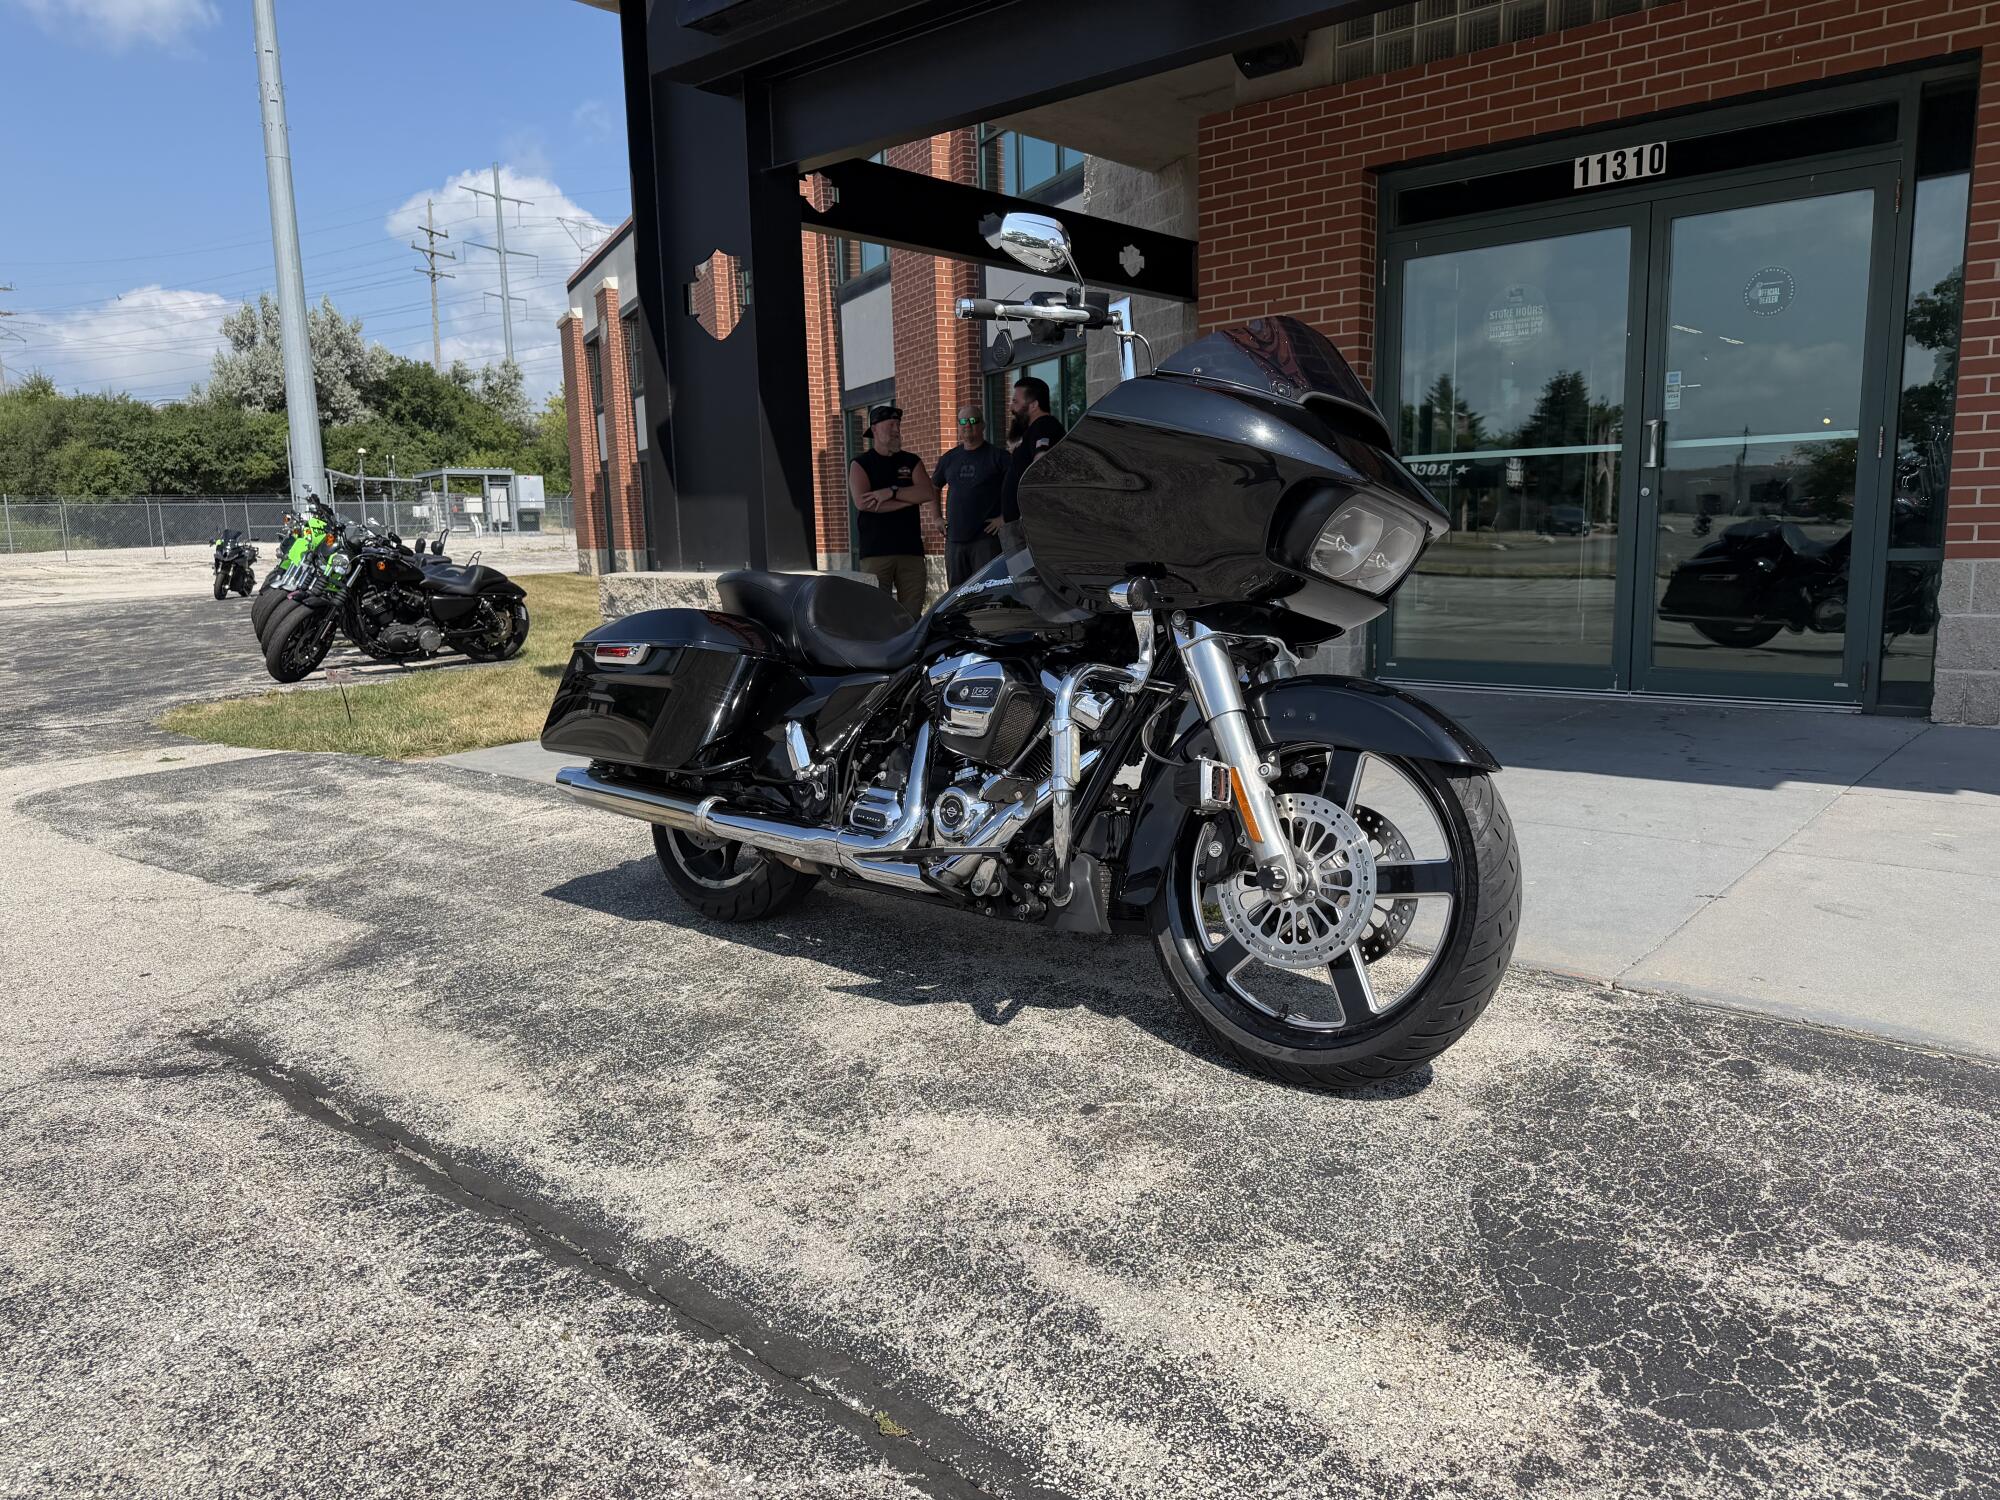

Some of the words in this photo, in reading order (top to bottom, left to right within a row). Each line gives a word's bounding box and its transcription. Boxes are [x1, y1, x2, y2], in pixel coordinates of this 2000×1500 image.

[1578, 143, 1665, 186] 11310
[1489, 308, 1514, 320] STORE
[1515, 304, 1544, 318] HOURS
